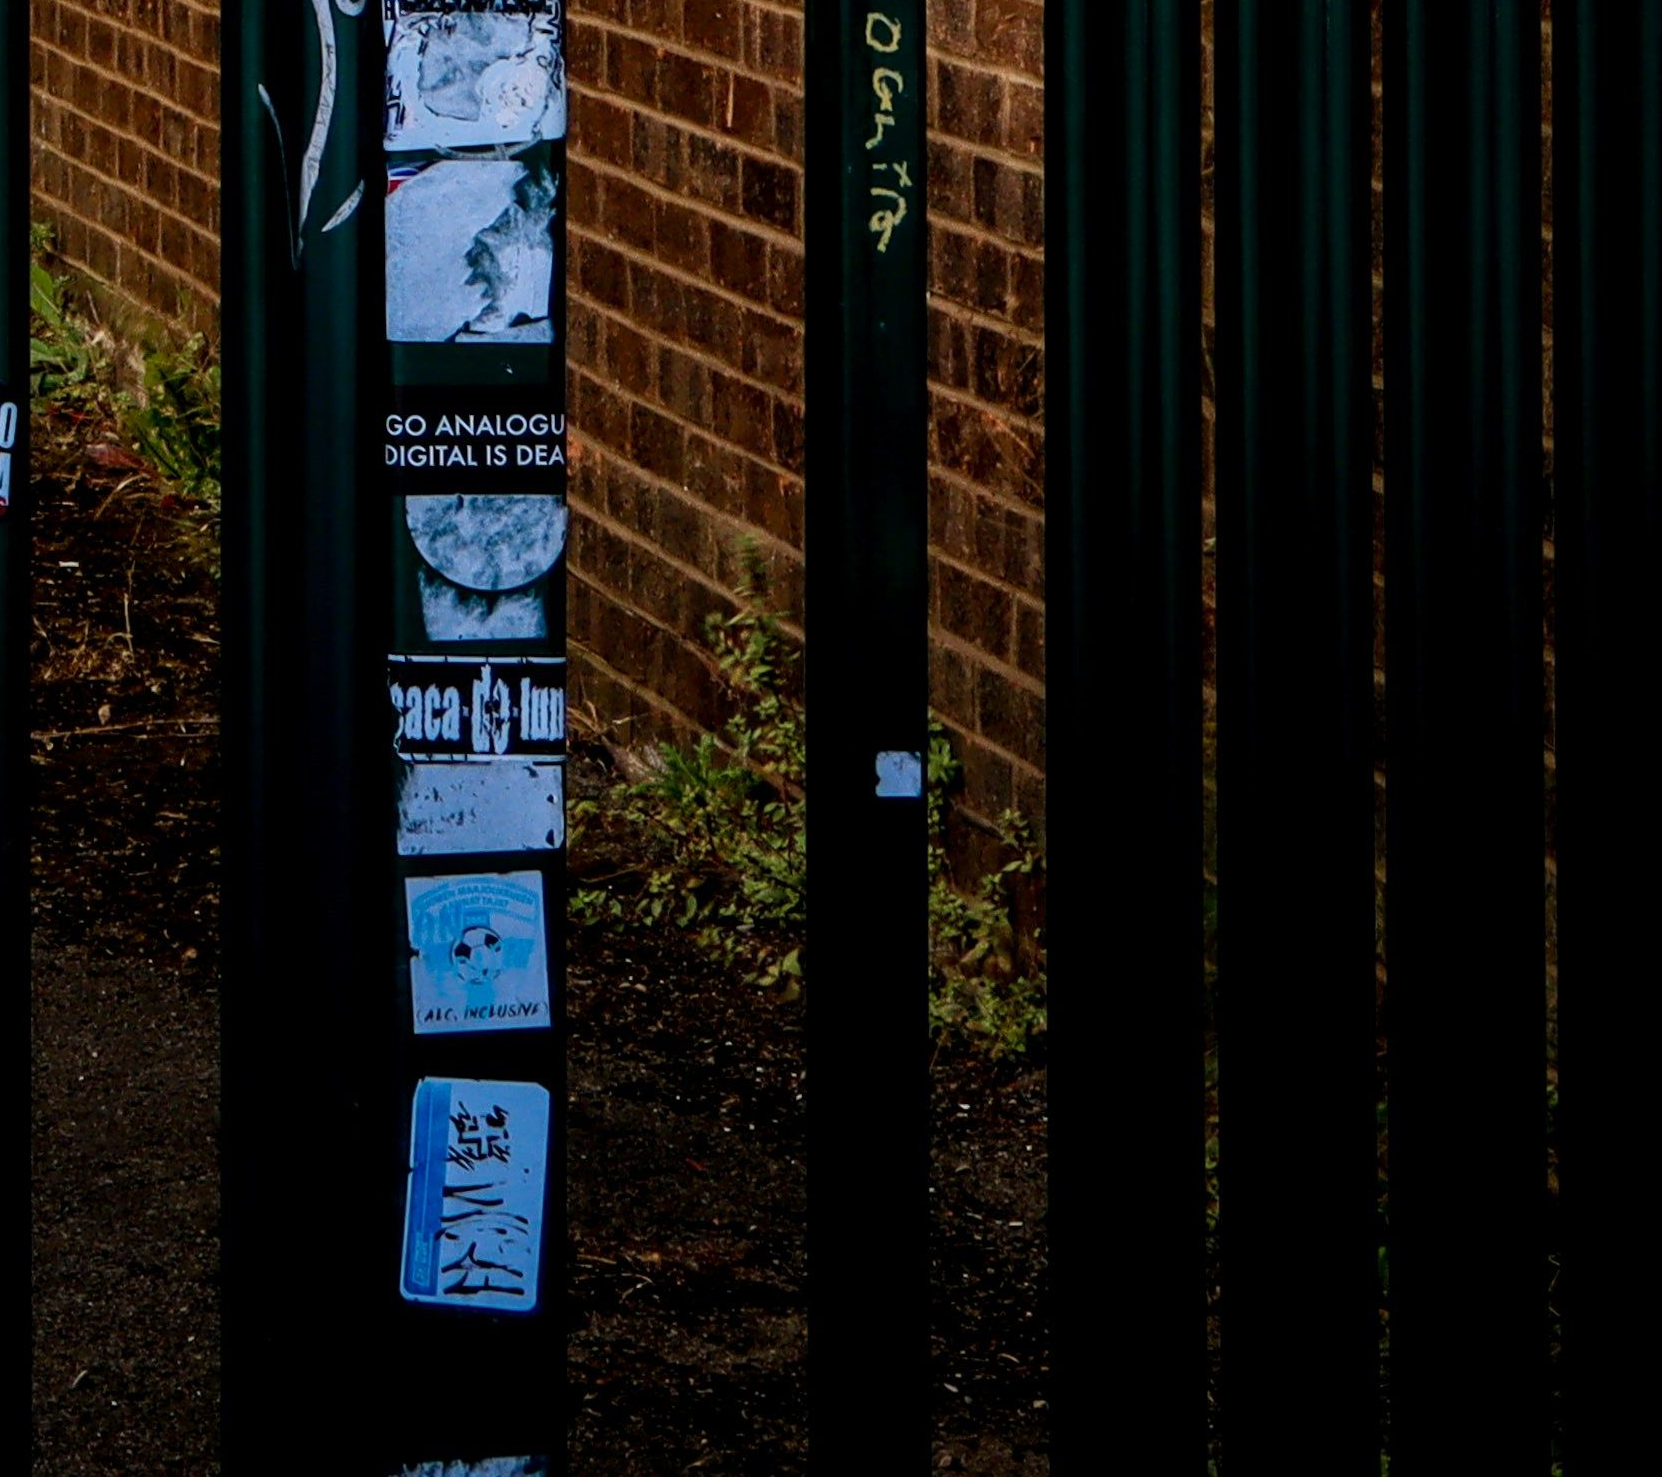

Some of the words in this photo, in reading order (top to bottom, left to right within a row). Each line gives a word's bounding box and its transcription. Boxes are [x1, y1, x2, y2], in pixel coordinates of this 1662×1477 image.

[386, 414, 430, 436] GO
[385, 444, 479, 467] DIGITAL
[486, 444, 509, 466] IS
